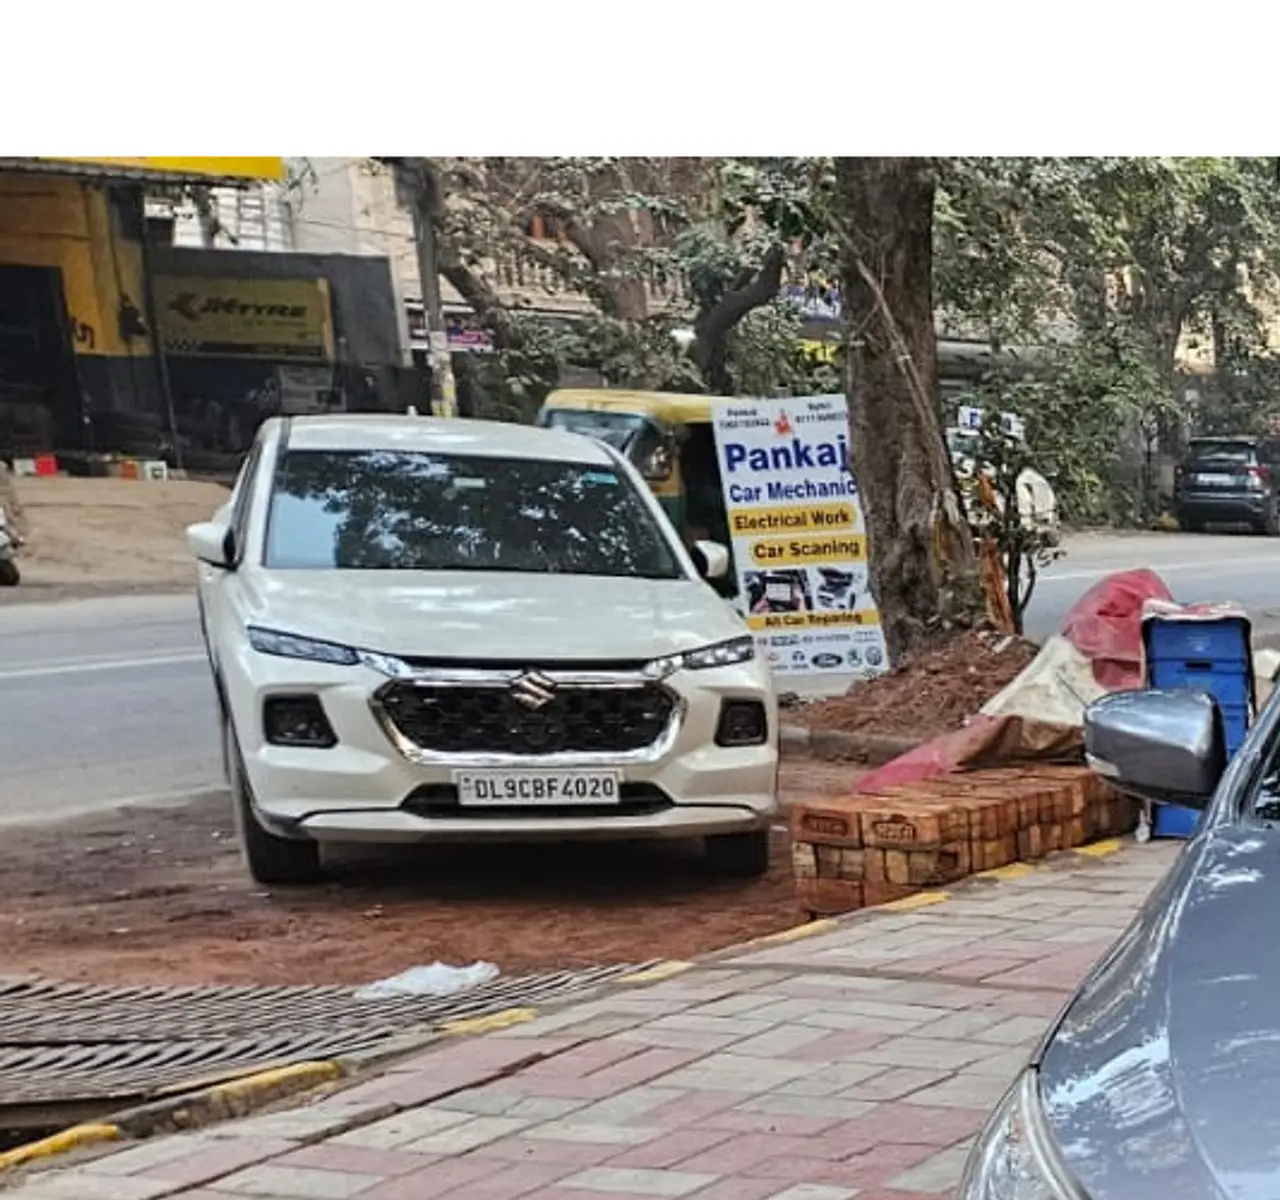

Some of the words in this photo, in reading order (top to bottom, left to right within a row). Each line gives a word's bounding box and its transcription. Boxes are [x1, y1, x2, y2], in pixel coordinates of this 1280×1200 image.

[724, 434, 847, 473] Pankaj
[729, 484, 762, 503] Car
[766, 478, 857, 500] Mechanic
[734, 511, 807, 531] Electrical
[812, 508, 850, 526] Work
[753, 544, 784, 559] Car
[789, 539, 860, 557] Scaning
[475, 776, 614, 799] DL9CBF4020
